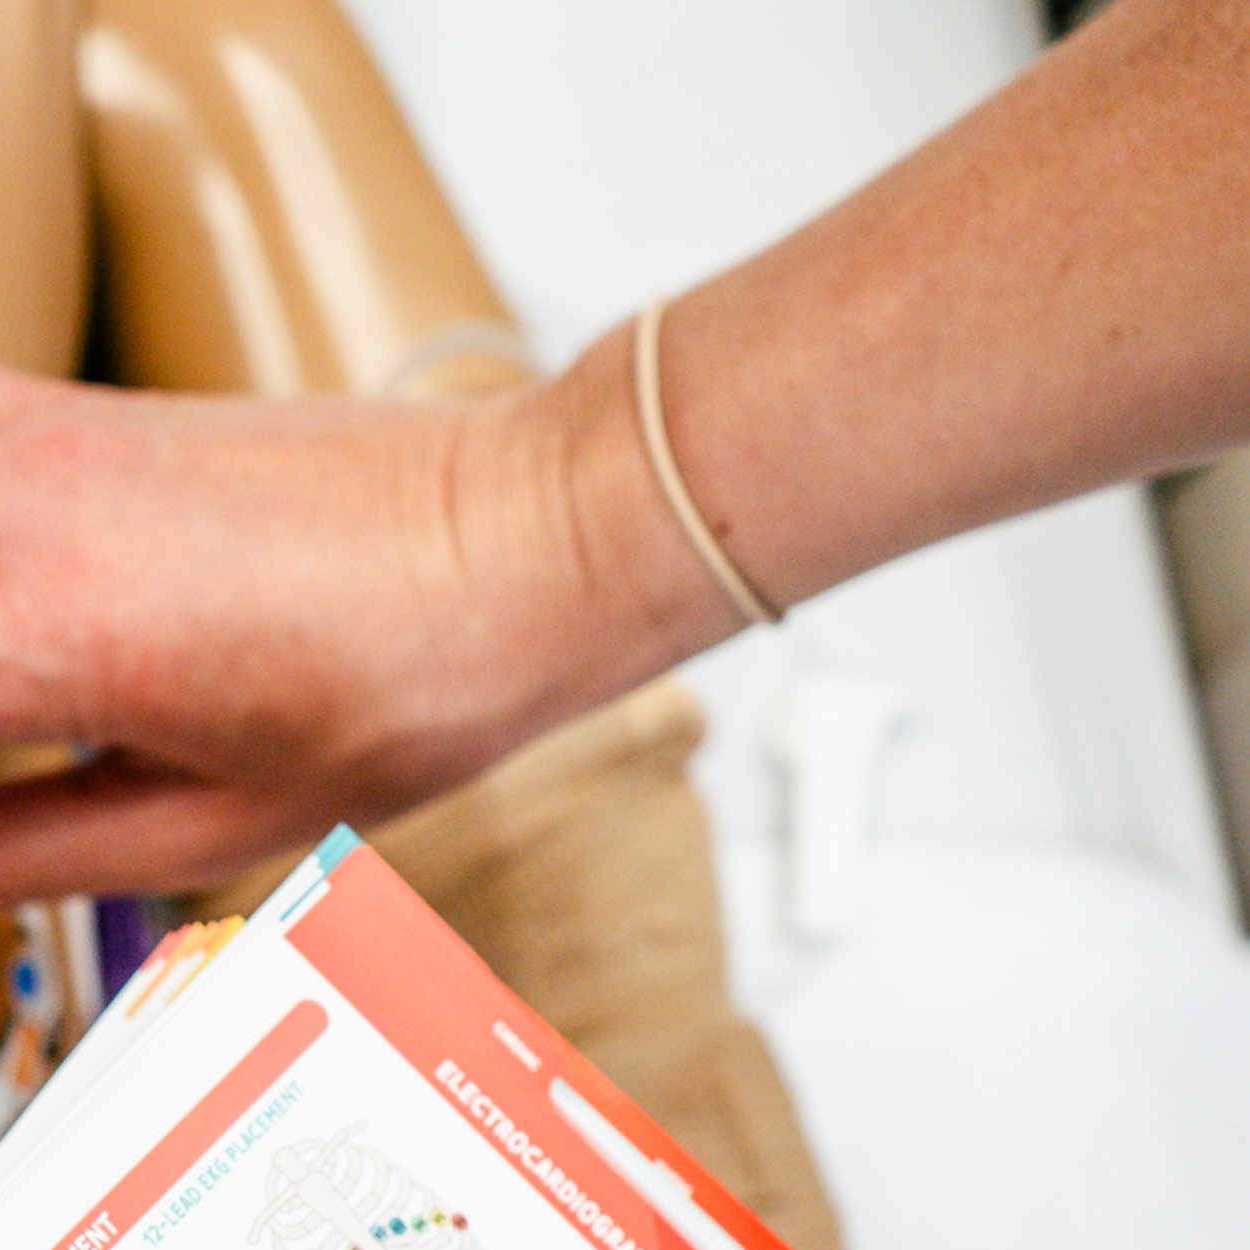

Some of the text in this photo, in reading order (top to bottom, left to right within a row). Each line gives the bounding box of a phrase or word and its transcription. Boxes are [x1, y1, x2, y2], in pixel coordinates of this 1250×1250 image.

[141, 1078, 303, 1247] 12-LEAD EKG PLACEMENT
